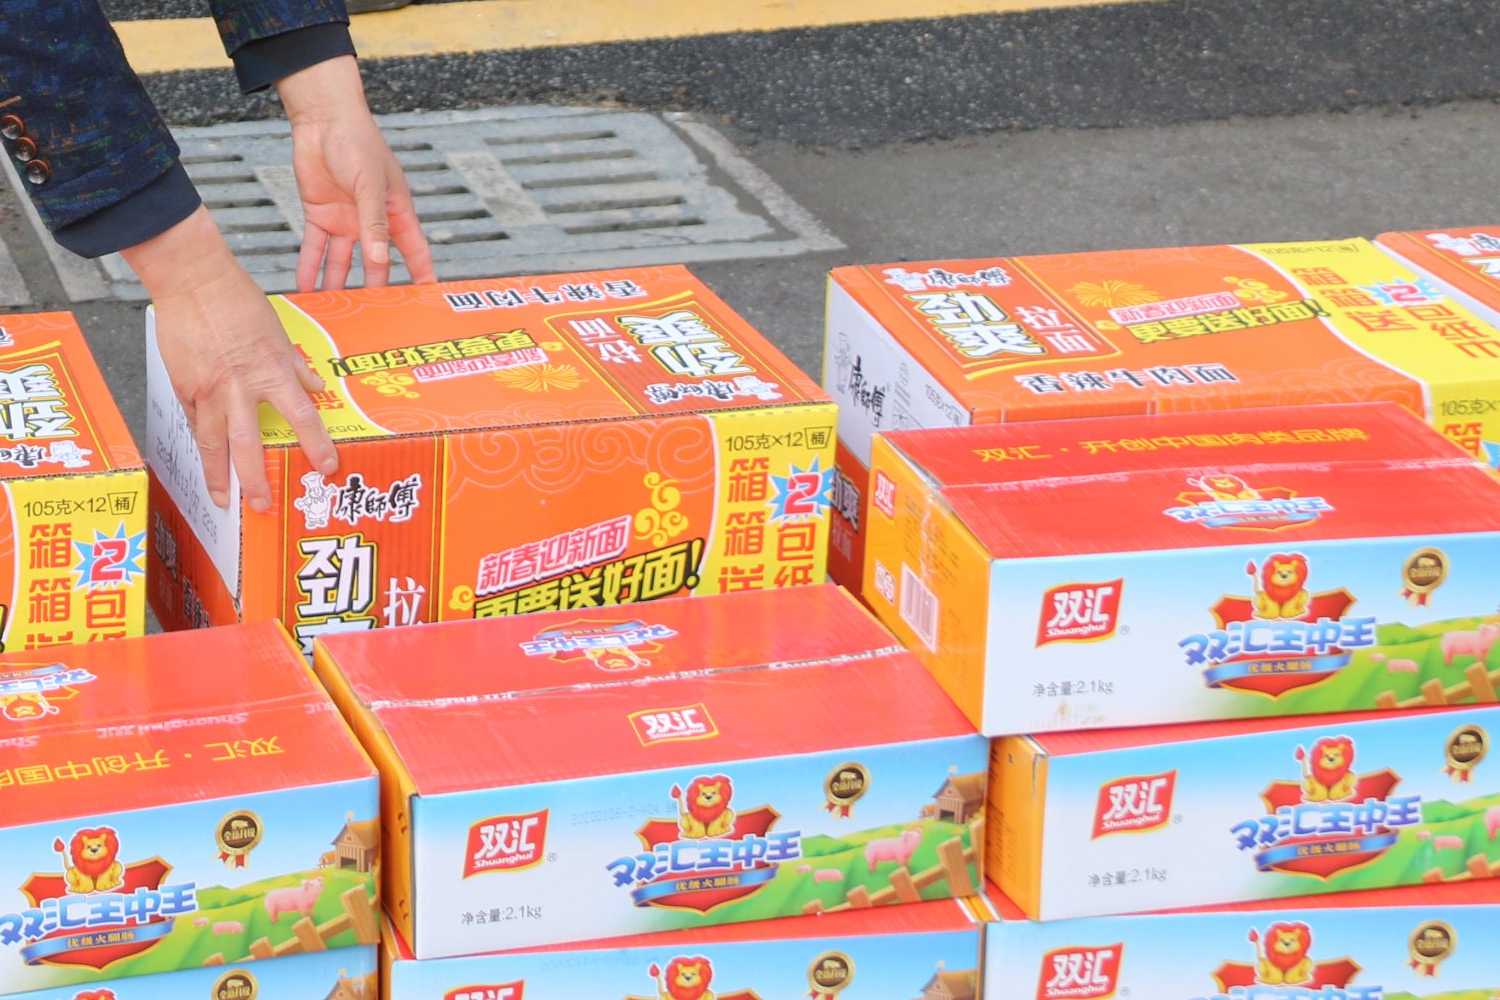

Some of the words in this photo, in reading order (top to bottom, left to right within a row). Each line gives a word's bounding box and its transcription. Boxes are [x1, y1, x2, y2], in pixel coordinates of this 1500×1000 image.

[445, 280, 648, 311] 香辣牛肉面
[568, 317, 643, 364] 拉面
[907, 291, 1047, 358] 劲爽
[1016, 306, 1098, 353] 拉面
[614, 311, 756, 377] 劲爽
[1014, 363, 1240, 394] 香辣牛肉面
[335, 474, 421, 523] 康師傅
[476, 514, 632, 597] 新春迎新面
[1051, 588, 1112, 627] 双汇
[1046, 621, 1107, 640] Shuanghui
[1178, 614, 1379, 668] 双汇王中王
[1032, 678, 1114, 698] 净含量:2.1kg
[641, 709, 704, 734] 双汇
[1102, 778, 1168, 822] 双汇
[474, 821, 538, 857] 双汇
[1101, 812, 1161, 831] Shuanghui
[1230, 795, 1423, 852] 双汇王中王
[473, 850, 534, 869] Shuanghui
[605, 827, 804, 889] 双汇王中王
[1087, 867, 1167, 888] 净含量:2.1kg
[461, 904, 542, 927] 净含量:2.1kg
[1046, 950, 1111, 988] 双汇
